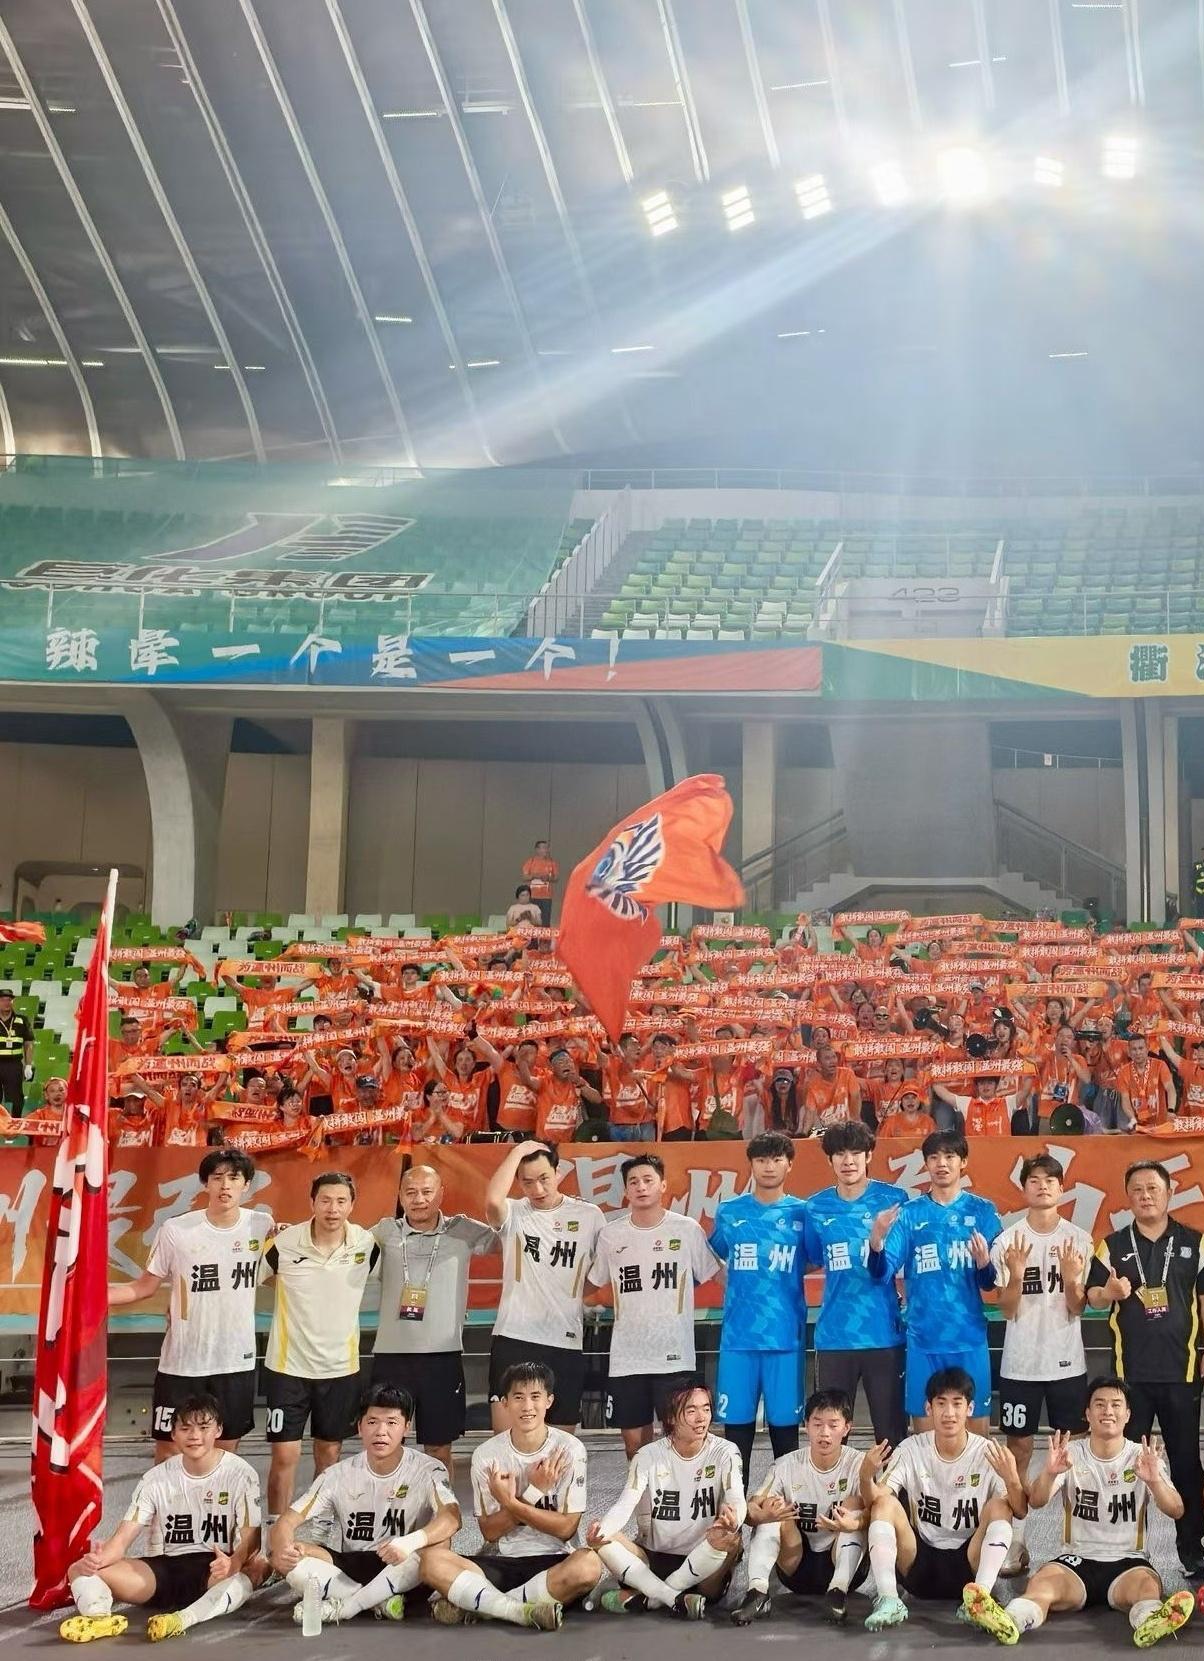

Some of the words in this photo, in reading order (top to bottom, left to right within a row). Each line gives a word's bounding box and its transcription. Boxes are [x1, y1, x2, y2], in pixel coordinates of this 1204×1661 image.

[734, 1242, 797, 1273] 温州
[914, 1238, 974, 1274] 温州
[191, 1260, 257, 1293] 温州
[619, 1262, 678, 1294] 温州
[1002, 1402, 1028, 1429] 36
[652, 1487, 717, 1522] 温州
[917, 1497, 980, 1532] 温州
[1073, 1487, 1138, 1524] 温州
[165, 1512, 228, 1545] 温州
[346, 1508, 406, 1542] 温州
